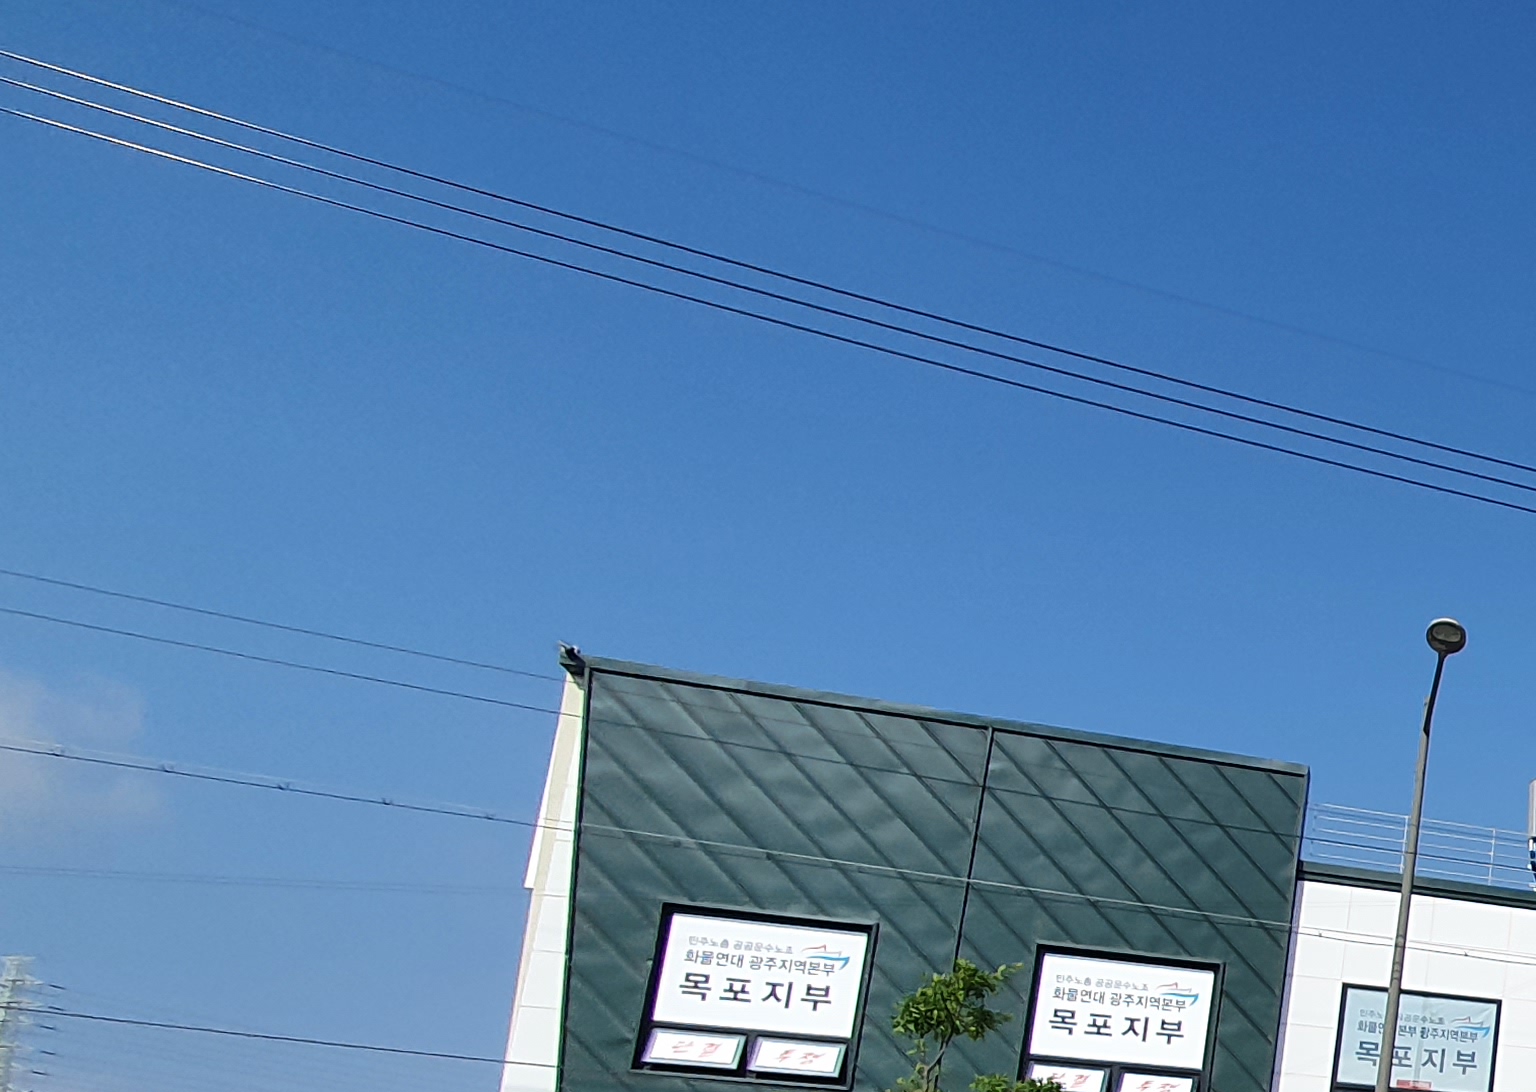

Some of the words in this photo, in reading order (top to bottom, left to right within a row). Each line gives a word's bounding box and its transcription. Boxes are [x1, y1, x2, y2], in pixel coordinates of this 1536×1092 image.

[683, 949, 744, 968] 화물연대
[749, 956, 836, 977] 광주지역본부
[678, 971, 832, 1012] 목포지부
[1110, 992, 1187, 1013] 광주지역본부
[1048, 1008, 1185, 1045] 목포지부
